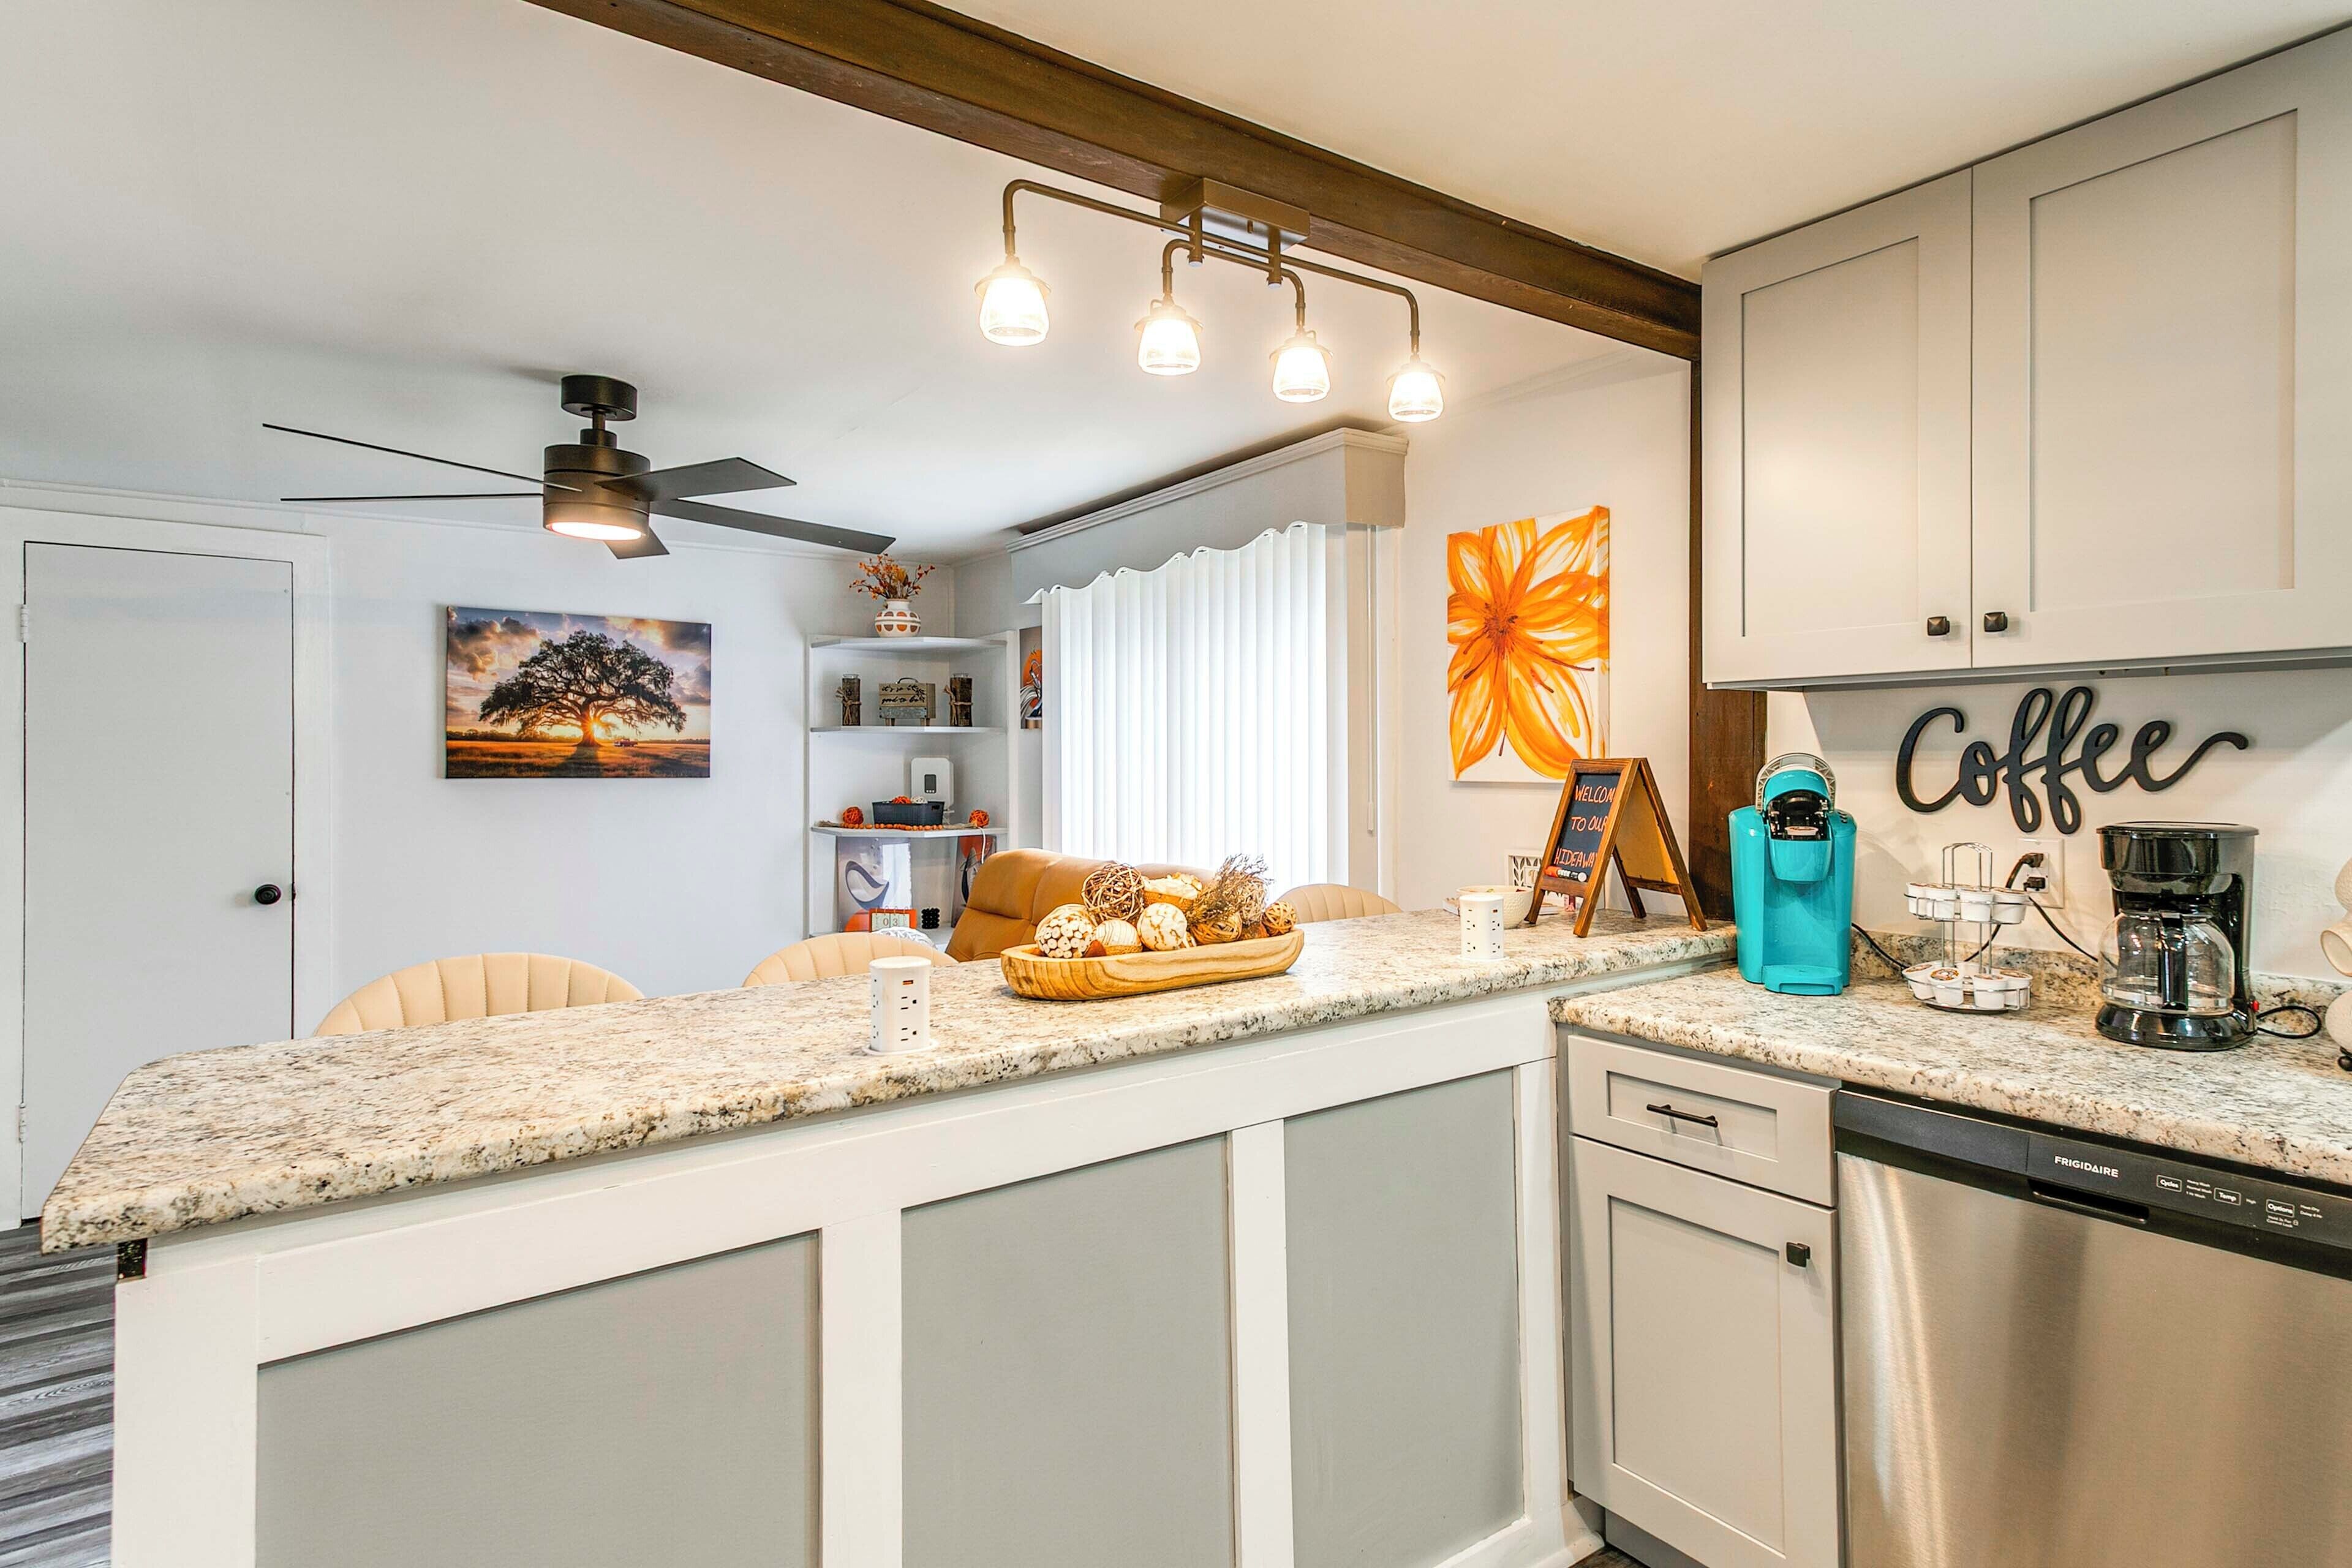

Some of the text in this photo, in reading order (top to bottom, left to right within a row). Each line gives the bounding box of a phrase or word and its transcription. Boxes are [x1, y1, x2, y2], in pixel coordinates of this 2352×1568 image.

[1896, 687, 2248, 834] Coffee
[1575, 784, 1616, 803] WELCOM
[1571, 816, 1586, 832] TO
[2054, 1155, 2119, 1178] FRIGIDAIRE
[2160, 1178, 2179, 1188] Cycles
[2218, 1191, 2237, 1202] Temp
[2267, 1203, 2293, 1214] Options
